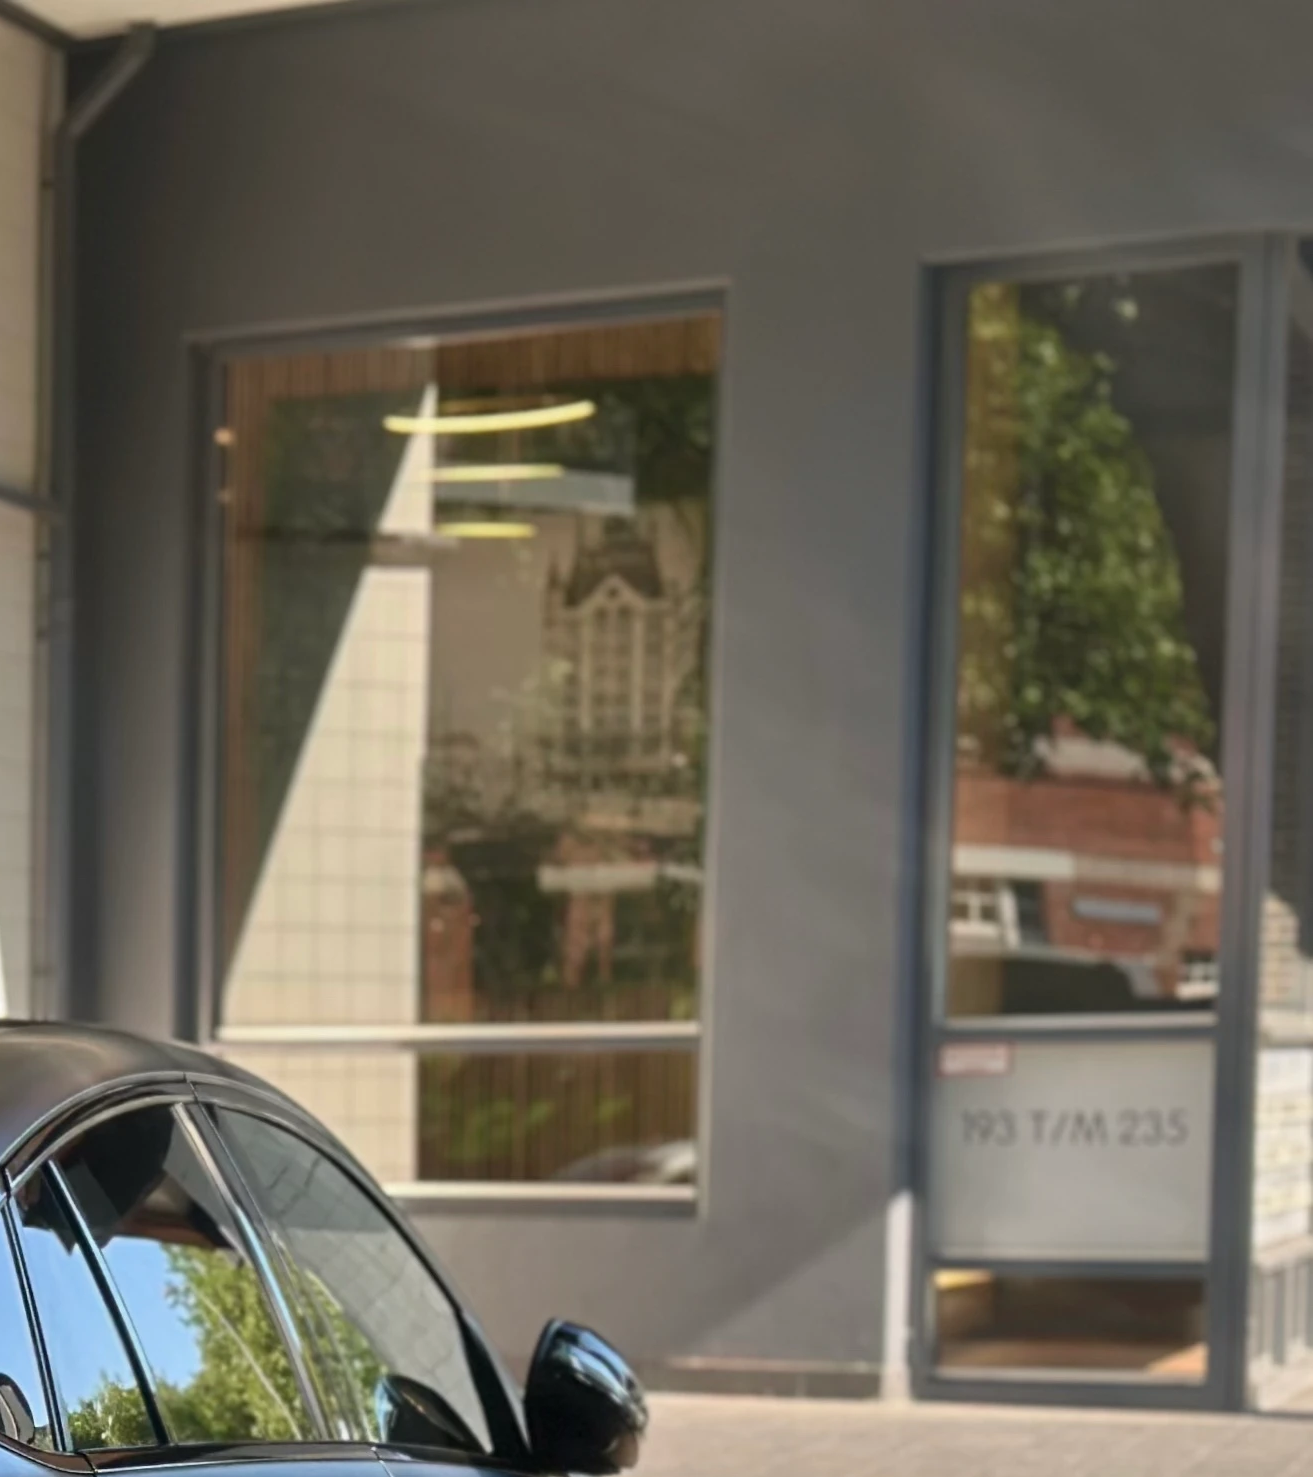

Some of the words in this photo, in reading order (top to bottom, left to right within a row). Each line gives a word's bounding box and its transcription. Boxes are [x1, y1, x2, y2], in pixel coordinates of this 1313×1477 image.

[960, 1107, 1017, 1147] 193
[1028, 1108, 1109, 1148] T/M
[1117, 1106, 1189, 1146] 235
